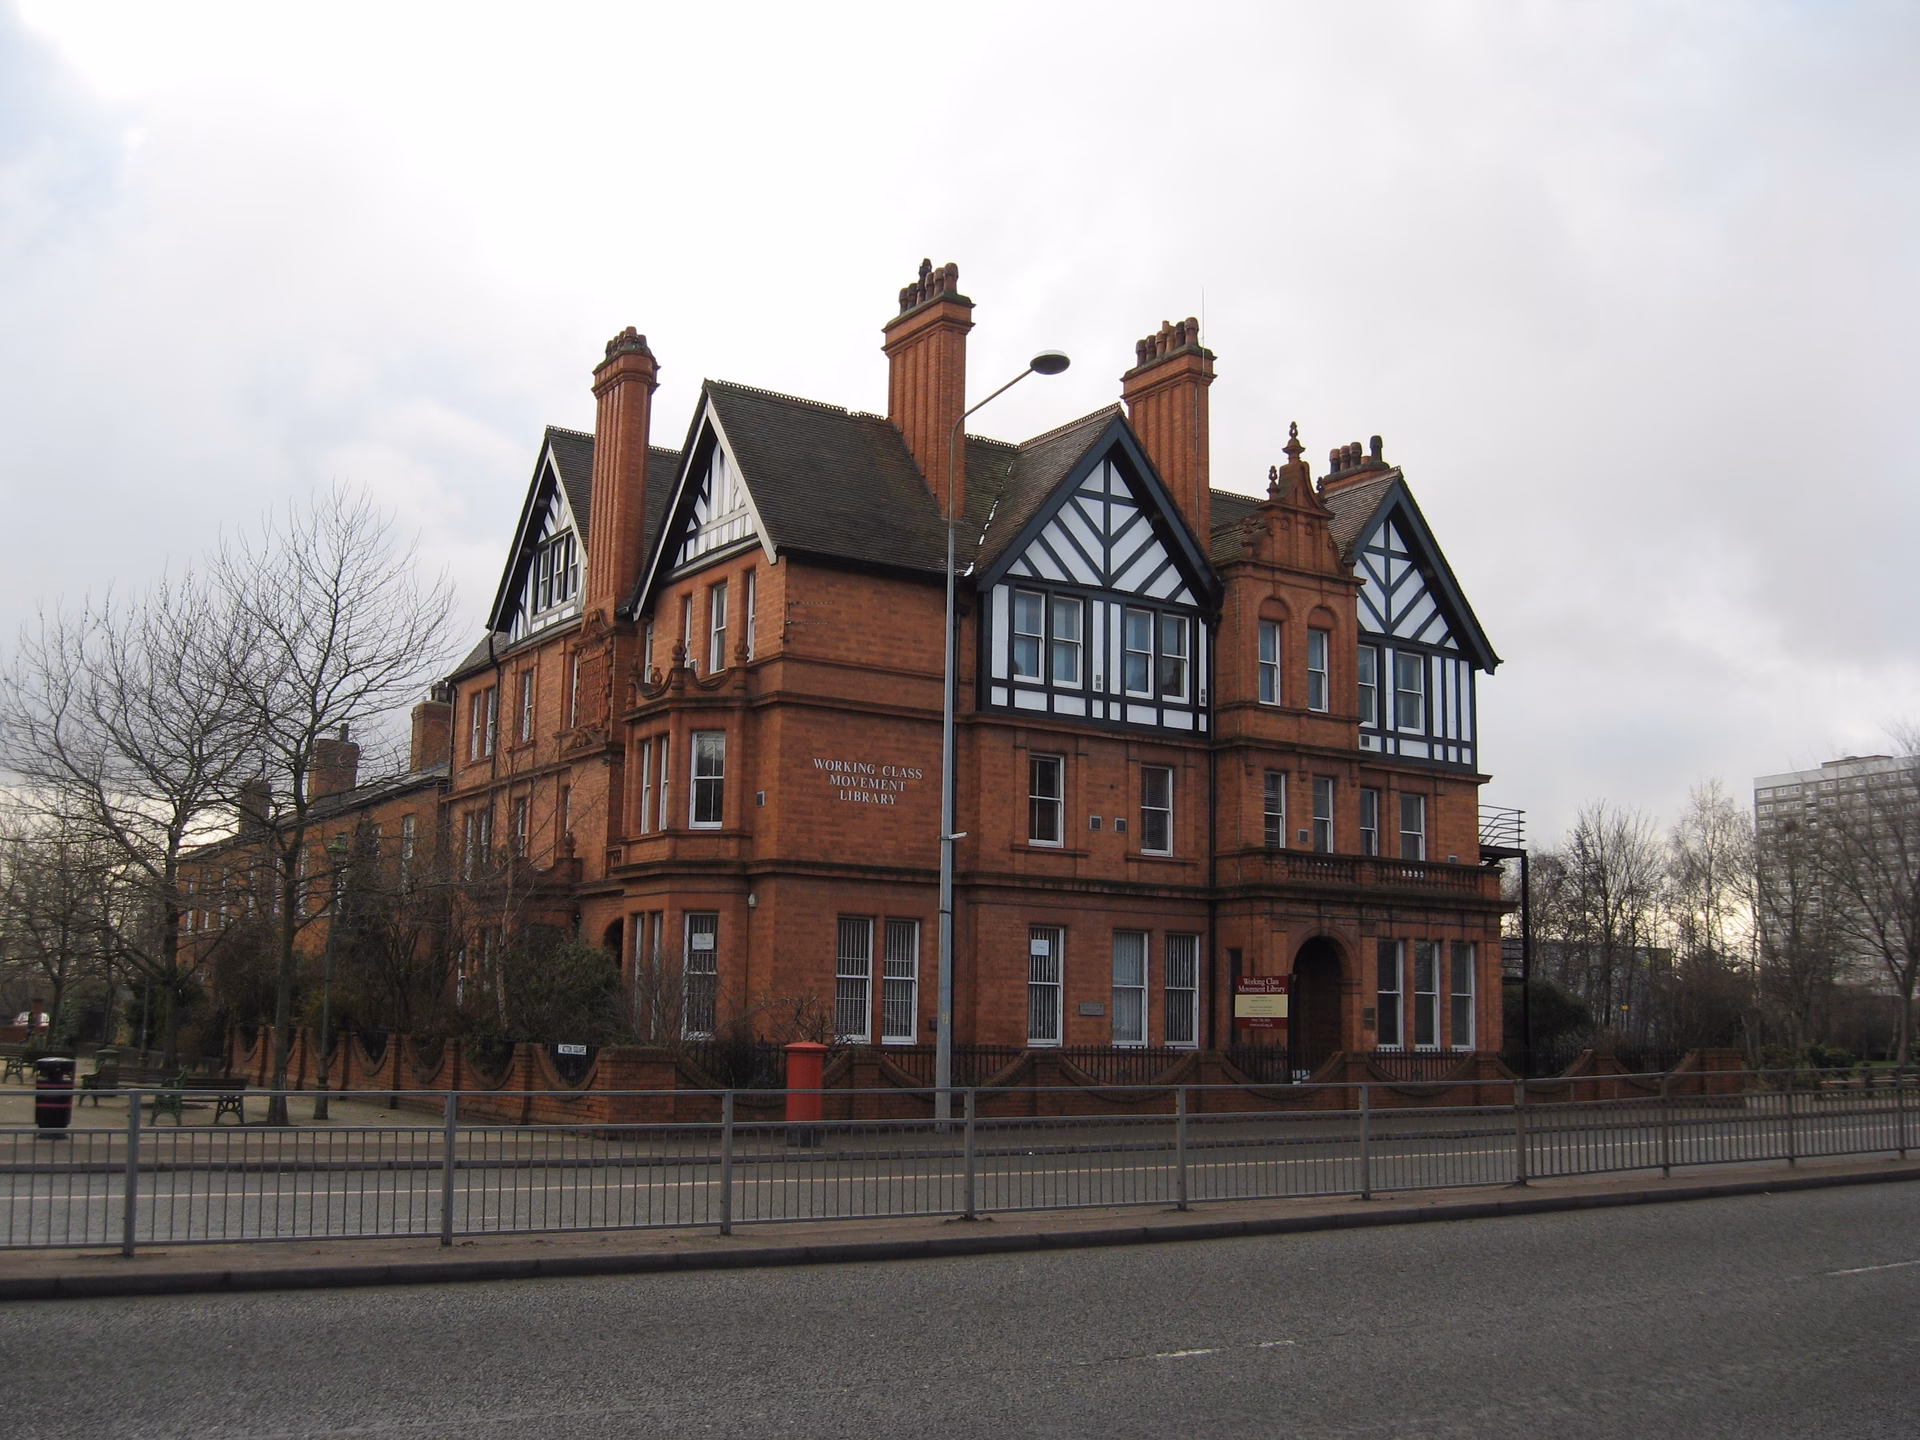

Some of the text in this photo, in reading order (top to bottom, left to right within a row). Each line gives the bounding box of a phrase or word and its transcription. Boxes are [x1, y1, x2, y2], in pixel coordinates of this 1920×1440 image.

[813, 758, 923, 780] WORKING CLASS
[829, 774, 907, 792] MOVEMENT
[840, 789, 897, 805] LIBRARY
[1243, 977, 1279, 986] Working Class
[1266, 985, 1285, 994] Library
